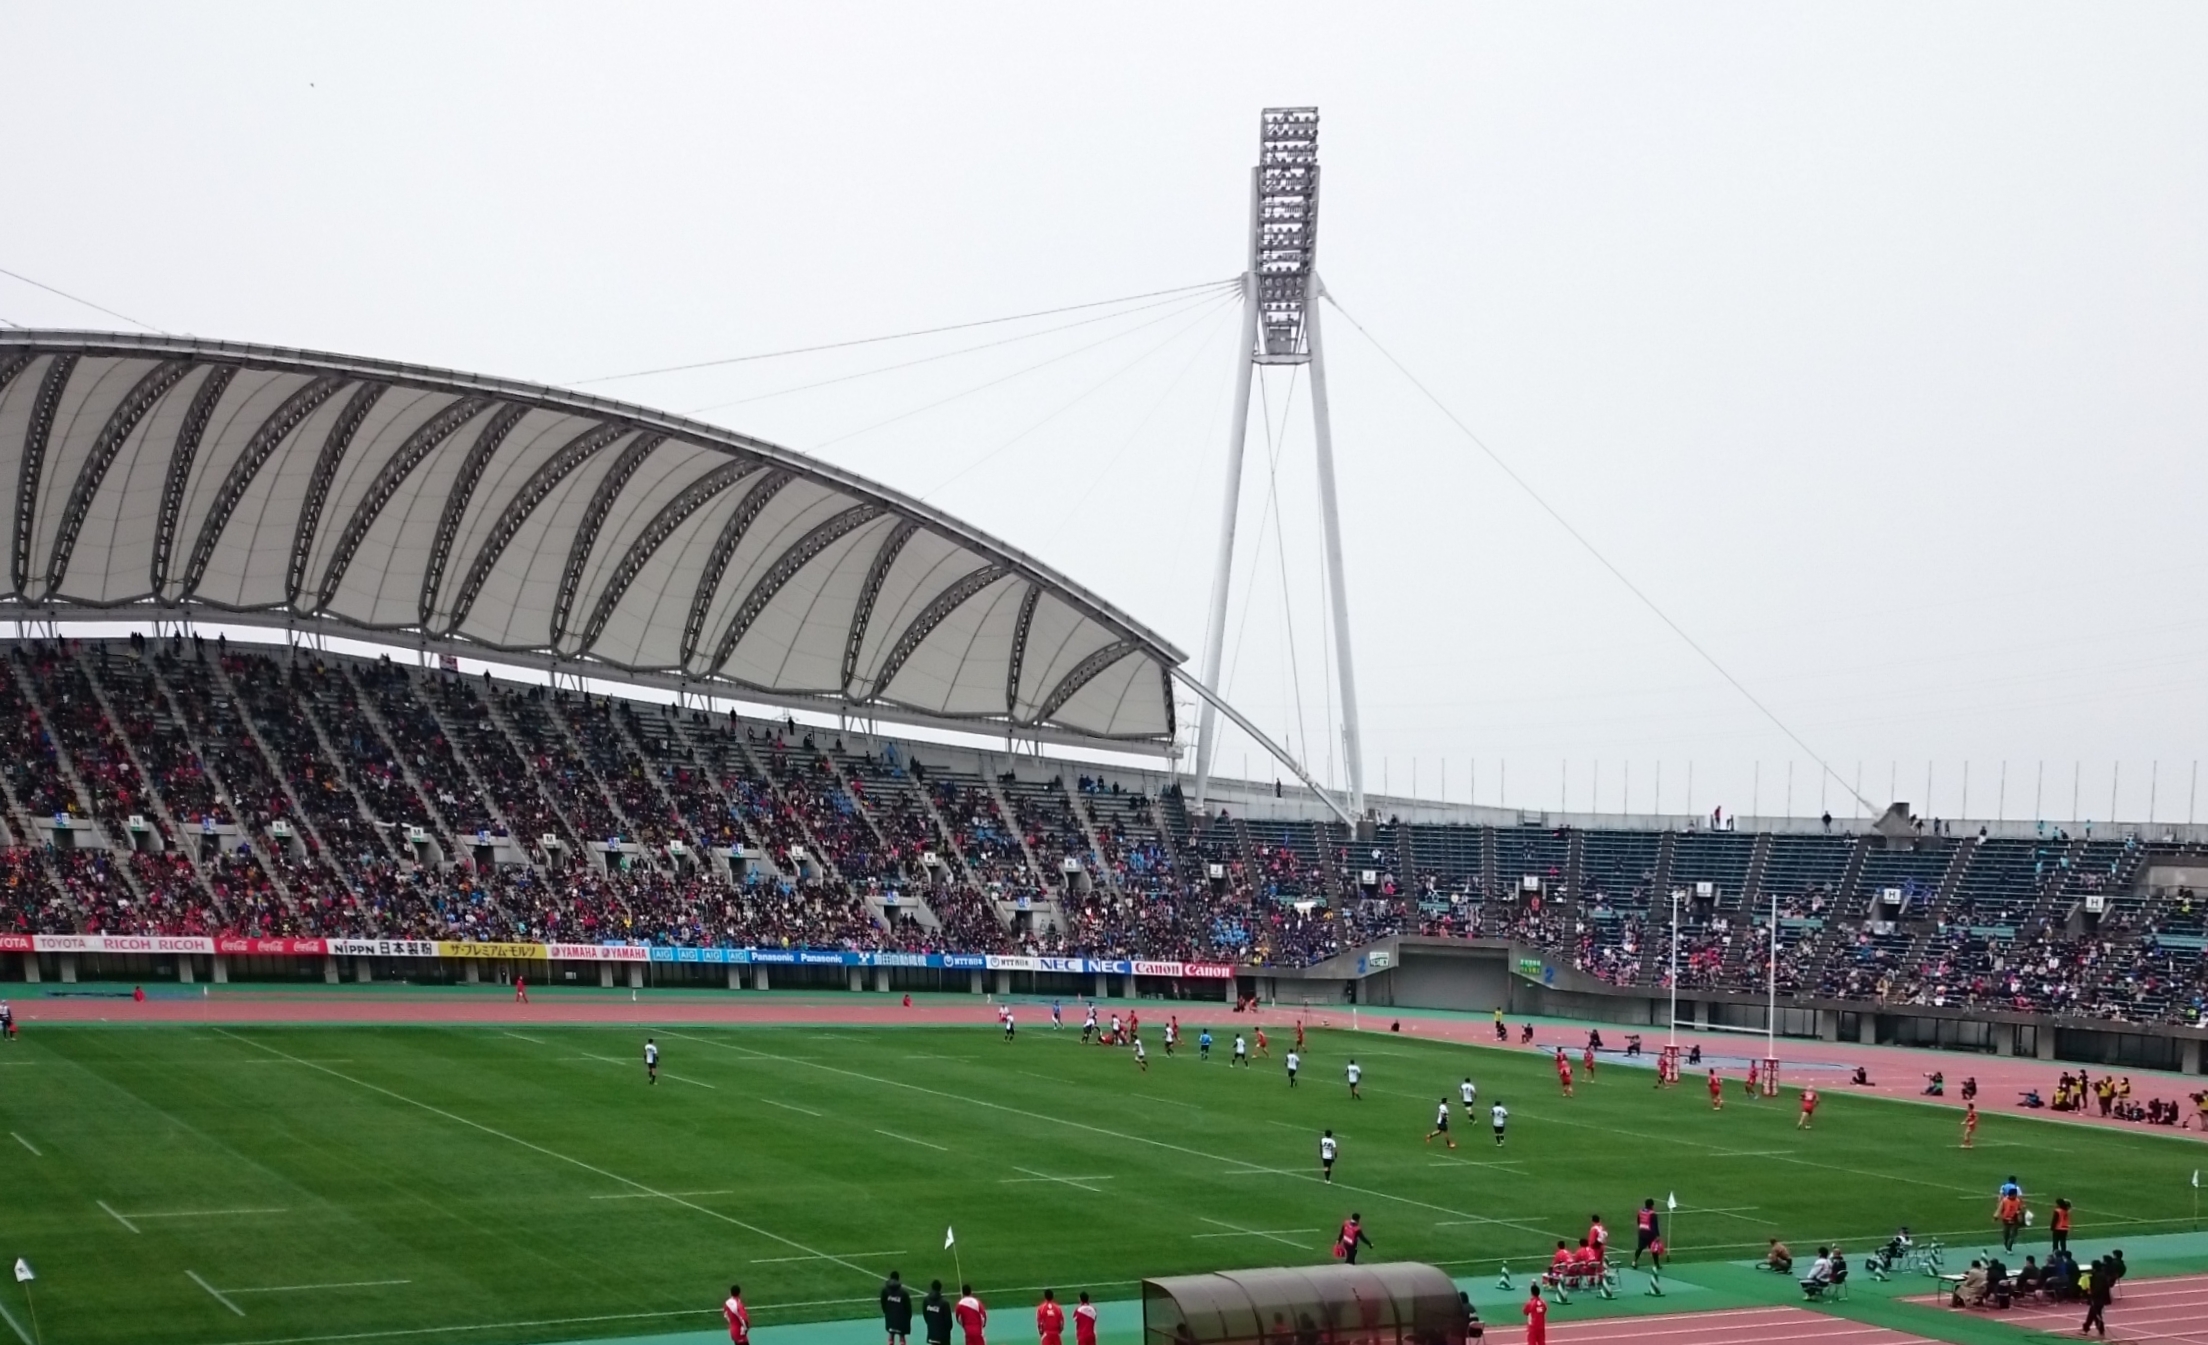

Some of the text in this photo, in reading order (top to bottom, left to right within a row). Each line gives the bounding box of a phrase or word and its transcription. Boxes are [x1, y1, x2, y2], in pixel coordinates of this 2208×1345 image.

[40, 938, 86, 948] TOYOTA
[103, 939, 205, 950] RICOH RICOH
[379, 942, 432, 955] 日本製粉
[561, 947, 647, 959] YAMAHA YAMAHA
[655, 951, 670, 959] AIG
[680, 951, 695, 959] AIG
[705, 952, 720, 960] AIG
[752, 952, 843, 963] Panasonic Panasonic
[1040, 959, 1076, 971] NEC
[1088, 961, 1126, 973] NEC
[1135, 963, 1180, 975] Canon
[1184, 963, 1230, 977] Canon
